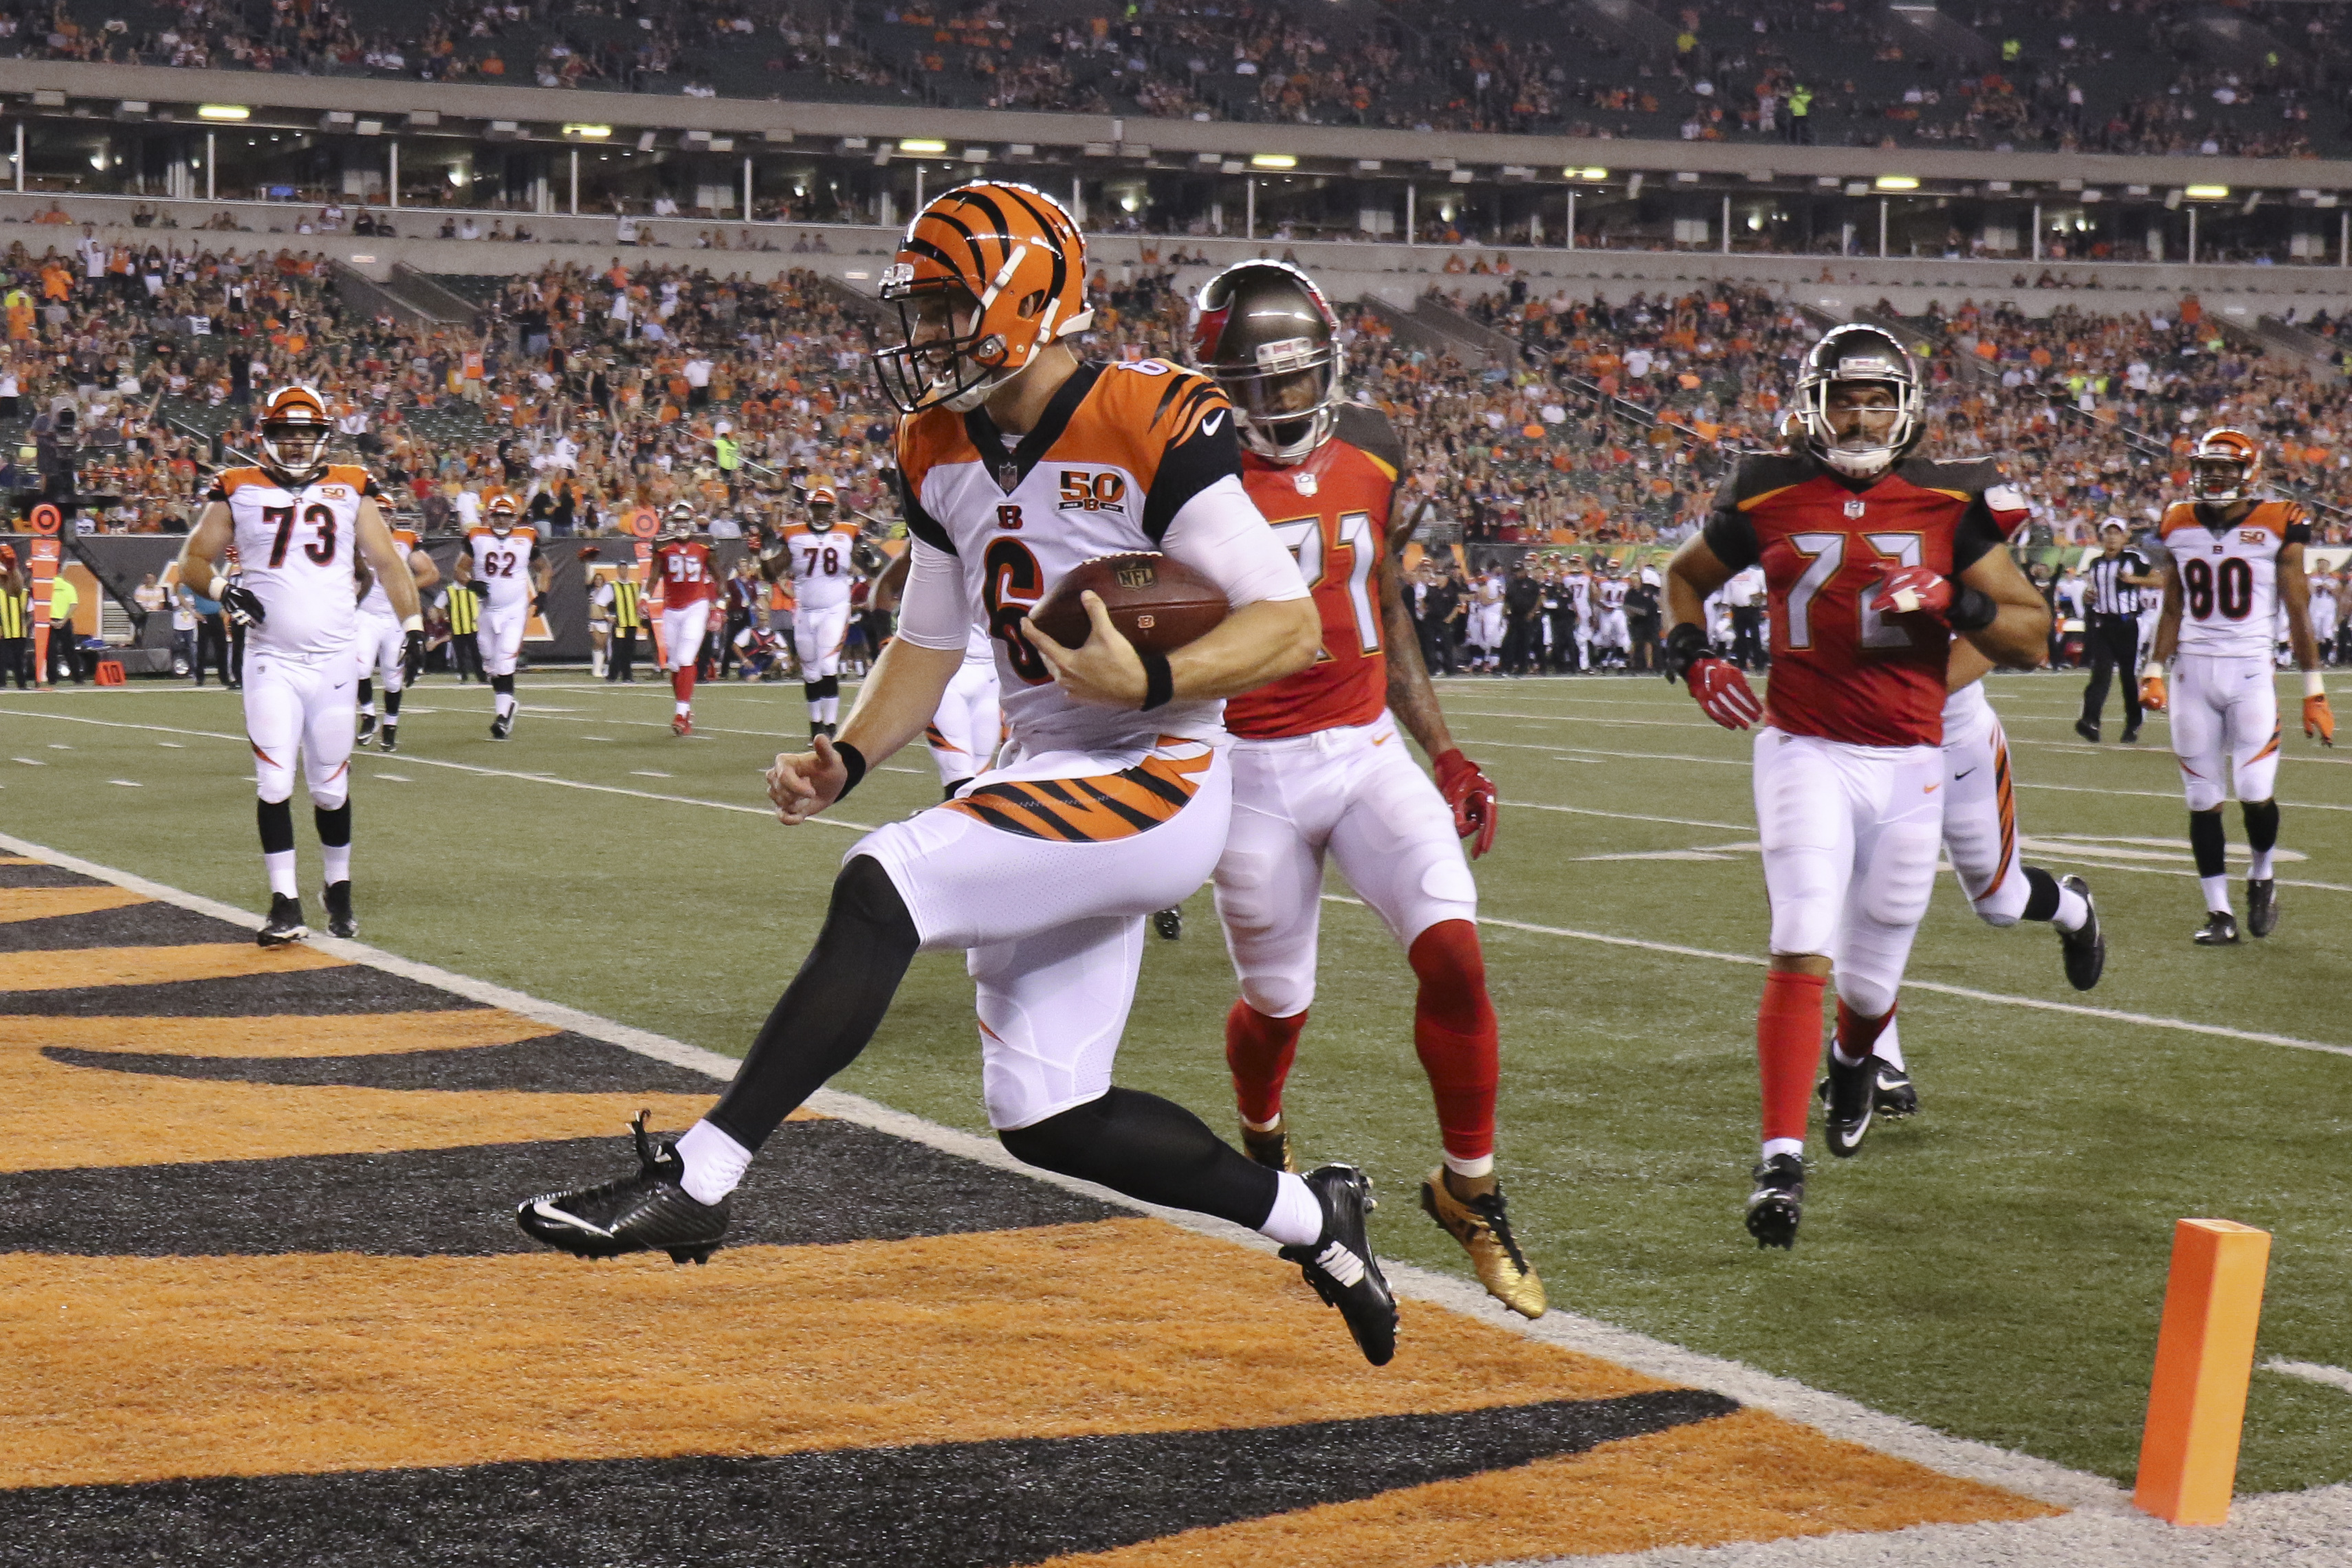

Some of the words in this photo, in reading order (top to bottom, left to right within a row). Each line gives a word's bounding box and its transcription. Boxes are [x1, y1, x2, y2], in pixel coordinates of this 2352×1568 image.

[1059, 470, 1125, 503] 50
[996, 505, 1023, 529] B
[263, 503, 338, 569] 73
[2239, 530, 2265, 544] 50
[485, 551, 516, 578] 62
[803, 546, 838, 577] 78
[1117, 568, 1155, 588] NFL
[1785, 530, 1925, 652] 72
[2184, 557, 2253, 621] 80
[981, 536, 1056, 686] 6
[103, 664, 122, 683] 10
